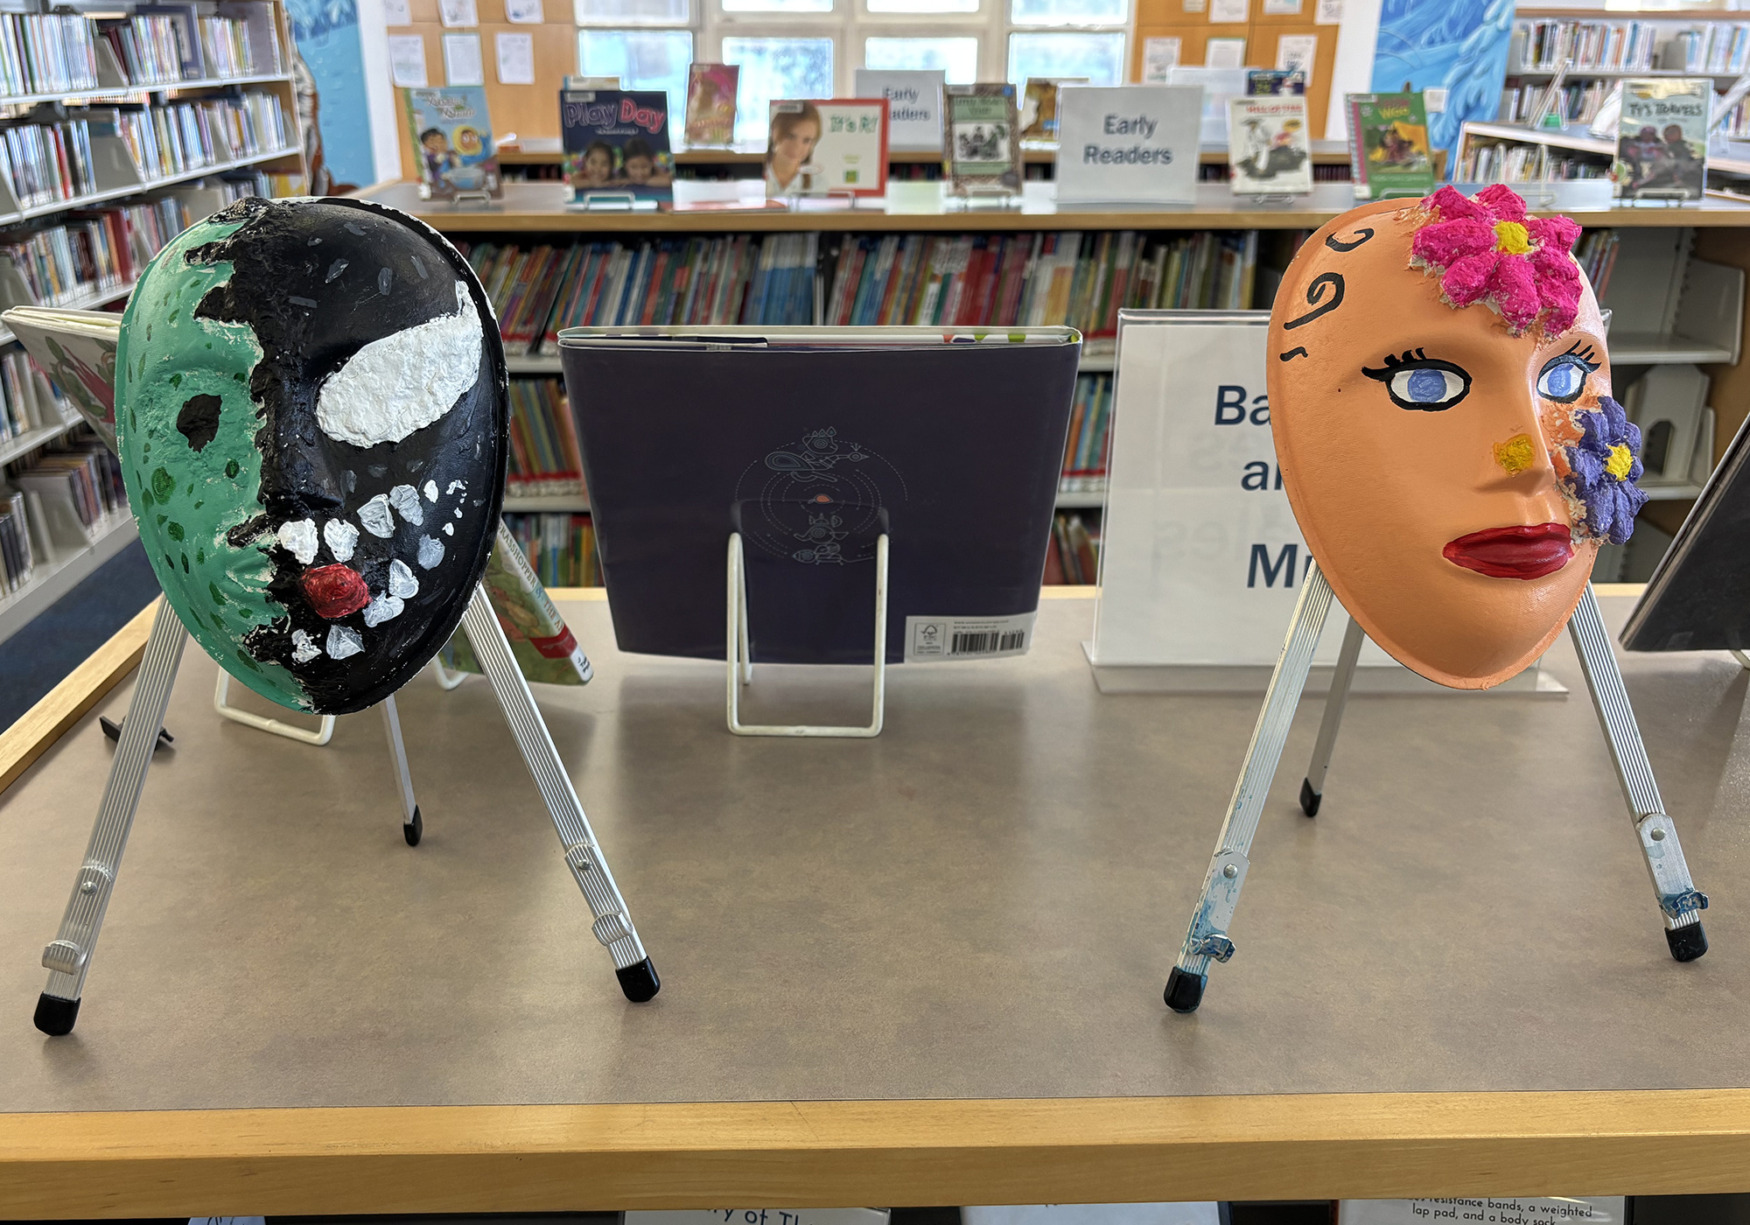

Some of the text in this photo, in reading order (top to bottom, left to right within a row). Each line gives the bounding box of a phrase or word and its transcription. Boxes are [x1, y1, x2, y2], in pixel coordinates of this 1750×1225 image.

[565, 98, 665, 134] Play Day
[1104, 114, 1158, 139] Early
[1083, 144, 1173, 165] Readers
[1214, 385, 1272, 426] Ba
[1412, 1203, 1430, 1218] lap
[1434, 1207, 1458, 1220] pad,
[1463, 1209, 1484, 1221] and
[1500, 1212, 1529, 1225] body
[1533, 1216, 1556, 1225] sock
[1488, 1198, 1524, 1212] bands,
[1540, 1204, 1593, 1218] weighted
